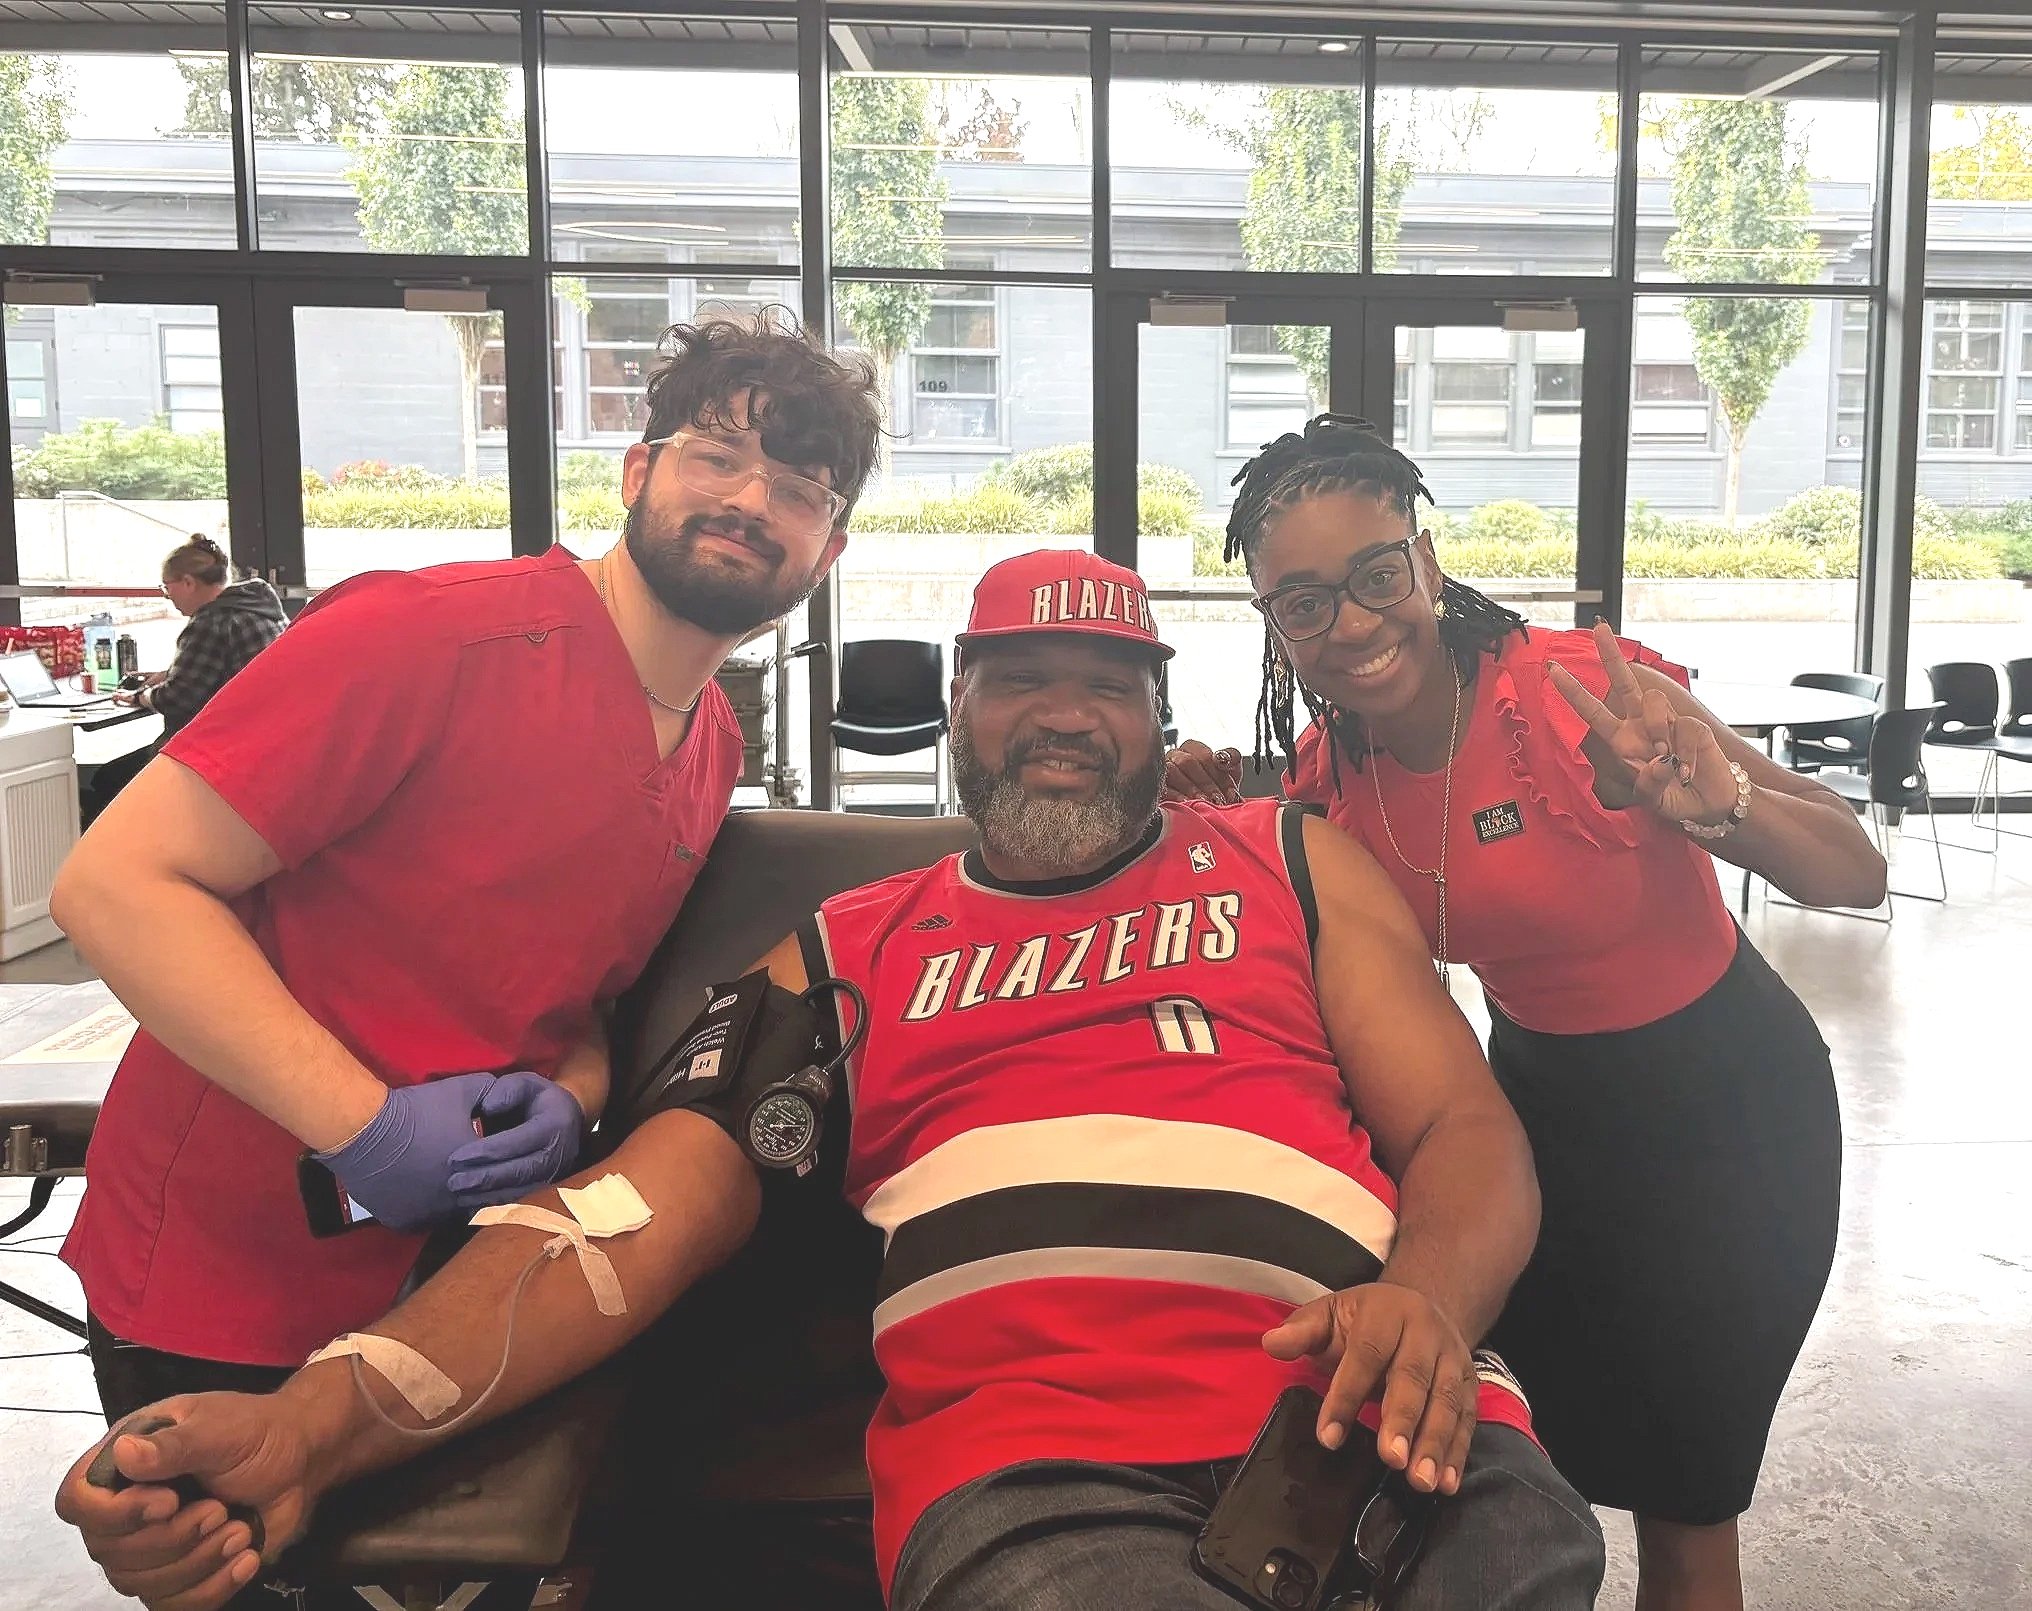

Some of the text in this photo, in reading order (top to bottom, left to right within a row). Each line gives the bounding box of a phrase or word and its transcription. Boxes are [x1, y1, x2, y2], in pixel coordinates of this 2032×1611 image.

[919, 380, 948, 393] 109
[1492, 807, 1504, 818] AM
[899, 890, 1243, 1024] BLAZERS
